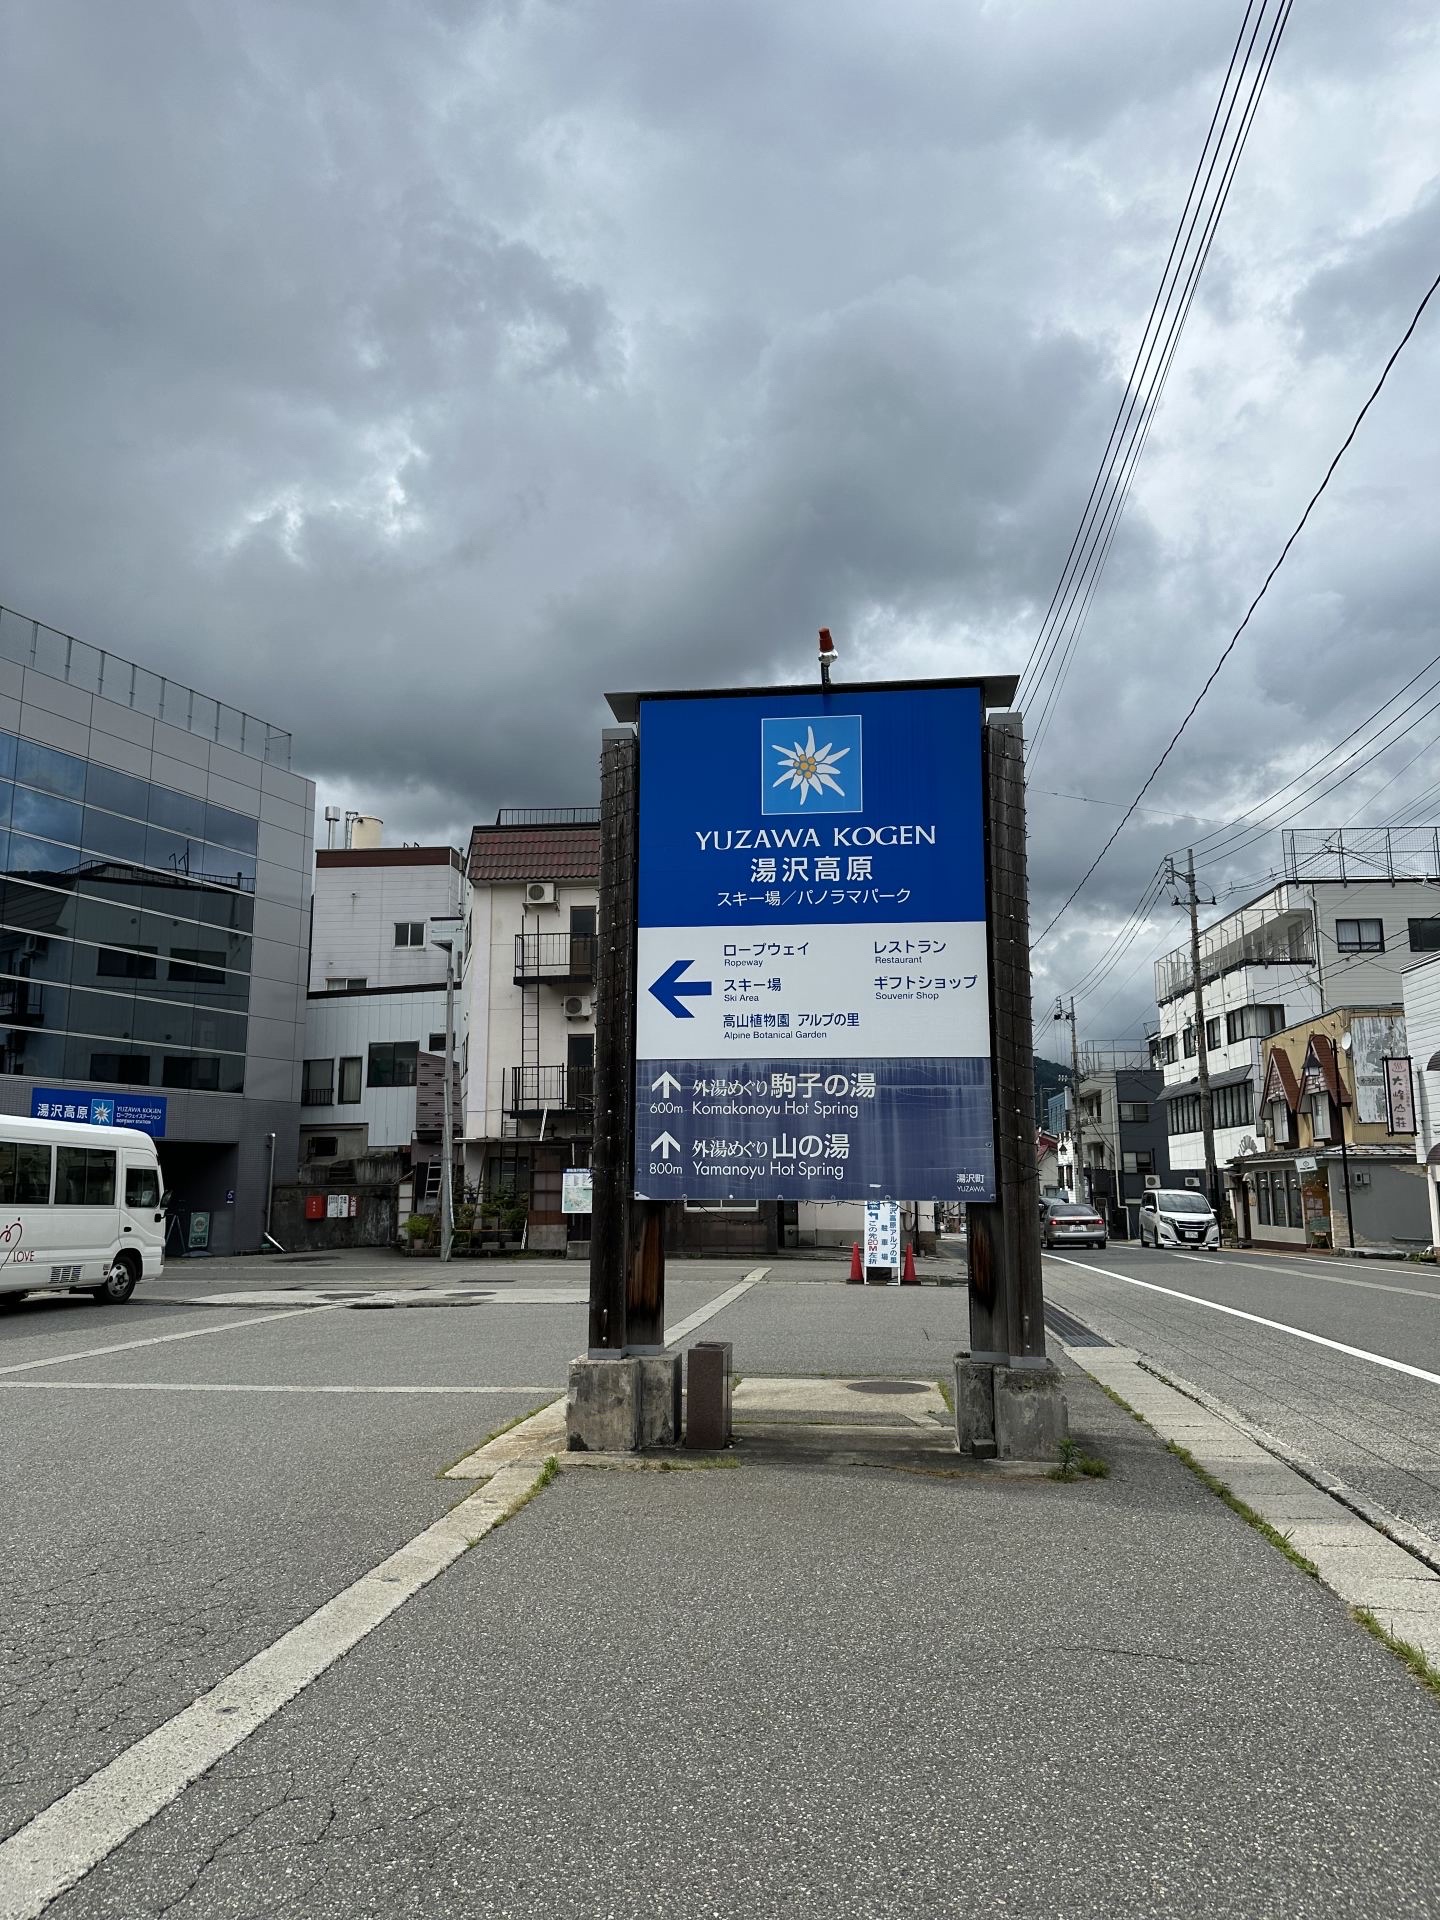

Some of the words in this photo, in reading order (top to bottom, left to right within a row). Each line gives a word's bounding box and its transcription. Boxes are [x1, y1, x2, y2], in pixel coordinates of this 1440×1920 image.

[695, 828, 821, 851] YUZAWA
[833, 825, 936, 847] KOGEN
[750, 855, 873, 883] 湯沢高原
[723, 942, 810, 957] ロープウェイ
[874, 940, 947, 954] レストラン
[724, 958, 764, 968] Ropeway
[875, 955, 922, 964] Restaurant
[723, 977, 782, 992] スキー場
[873, 974, 978, 990] ギフトショップ
[724, 994, 737, 1002] Ski
[739, 994, 760, 1002] Area
[875, 991, 914, 1000] Souvenir
[916, 991, 940, 1001] Shop
[723, 1013, 790, 1029] 高山植物園
[797, 1012, 860, 1027] アルプの里
[723, 1031, 751, 1041] Alpine
[753, 1030, 793, 1039] Botanical
[795, 1030, 827, 1039] Garden
[37, 1103, 89, 1119] 湯沢高原
[116, 1105, 141, 1114] YUZAWA
[649, 1102, 684, 1115] 600m
[692, 1099, 781, 1119] Komakonoyu
[784, 1100, 809, 1115] Hot
[813, 1100, 859, 1119] Spring
[649, 1162, 683, 1175] 800m
[692, 1160, 766, 1180] Yamanoyu
[769, 1161, 795, 1176] Hot
[798, 1161, 845, 1180] Spring
[956, 1173, 985, 1184] 湯沢町
[957, 1185, 985, 1193] YUZAWA
[12, 1250, 35, 1263] LOVE
